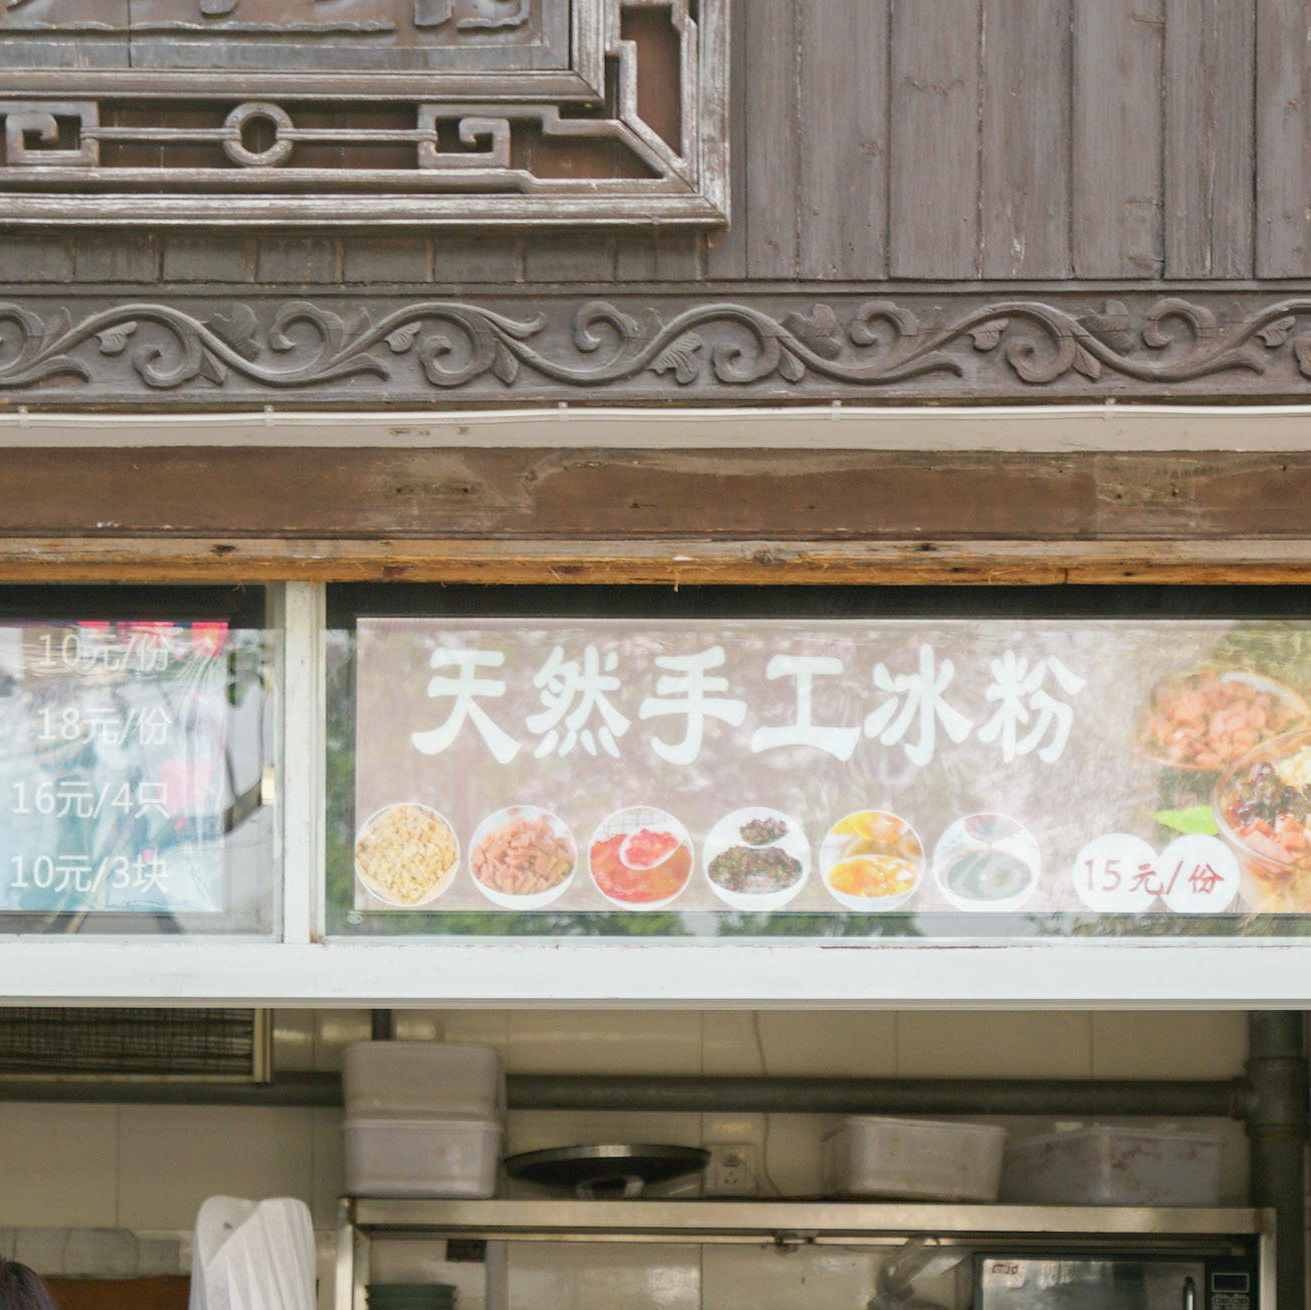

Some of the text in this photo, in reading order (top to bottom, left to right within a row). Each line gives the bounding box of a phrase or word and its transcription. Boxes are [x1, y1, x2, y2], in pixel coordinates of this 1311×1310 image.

[39, 633, 172, 673] 10元/份
[411, 643, 1086, 767] 天然手工冰粉
[38, 708, 172, 747] 18元/份
[12, 779, 169, 820] 16元/4只
[10, 854, 169, 894] 10元/3块
[1084, 859, 1225, 896] 15元/份
